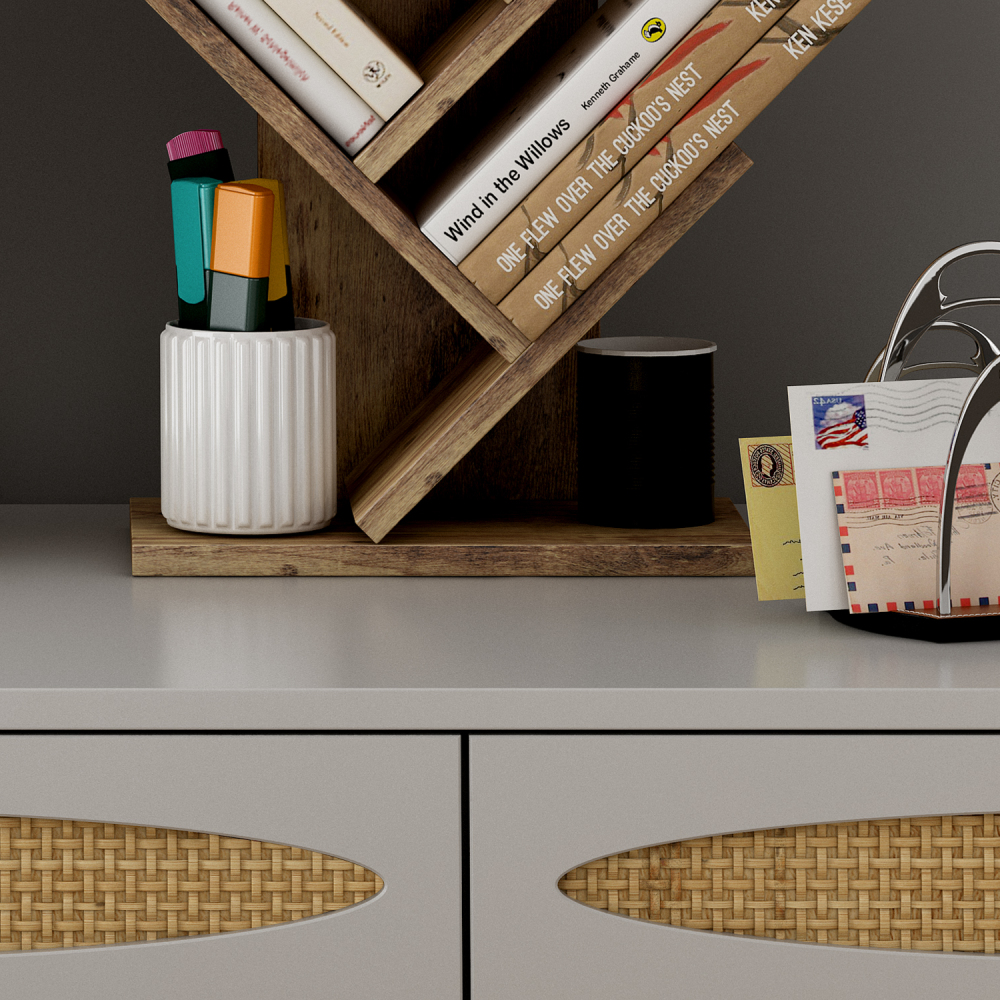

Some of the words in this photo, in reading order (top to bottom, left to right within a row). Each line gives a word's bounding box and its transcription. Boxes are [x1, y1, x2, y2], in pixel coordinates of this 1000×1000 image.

[580, 81, 611, 111] Kenneth
[608, 51, 641, 83] Grahame
[782, 24, 818, 60] KEN
[443, 202, 485, 242] Wind
[478, 192, 499, 209] in
[493, 169, 521, 194] the
[514, 119, 571, 171] Willows
[496, 241, 527, 273] ONE
[519, 206, 560, 249] FLEW
[555, 175, 594, 213] OVER
[585, 149, 619, 179] THE
[612, 95, 672, 155] CUCKOO'S
[664, 61, 702, 102] NEST
[533, 279, 564, 310] ONE
[557, 243, 597, 286] FLEW
[592, 213, 631, 250] OVER
[623, 186, 656, 217] THE
[649, 132, 709, 192] CUCKOO'S
[702, 99, 740, 139] NEST
